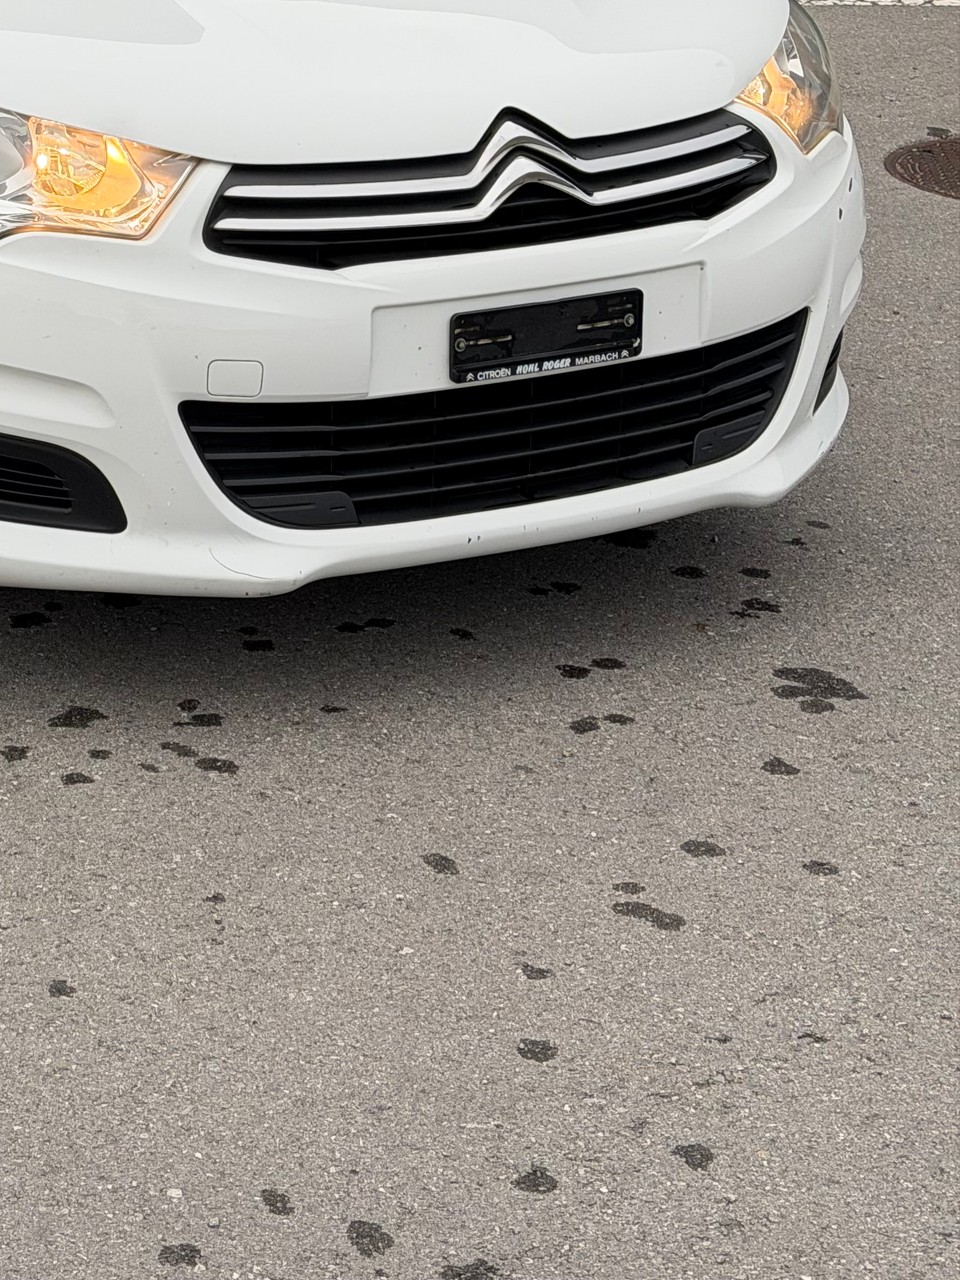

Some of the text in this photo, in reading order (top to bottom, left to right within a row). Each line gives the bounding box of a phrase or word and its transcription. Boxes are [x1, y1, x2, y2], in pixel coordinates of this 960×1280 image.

[477, 367, 511, 381] CITROËN
[542, 357, 571, 371] ROGER
[575, 352, 619, 366] MARBACH
